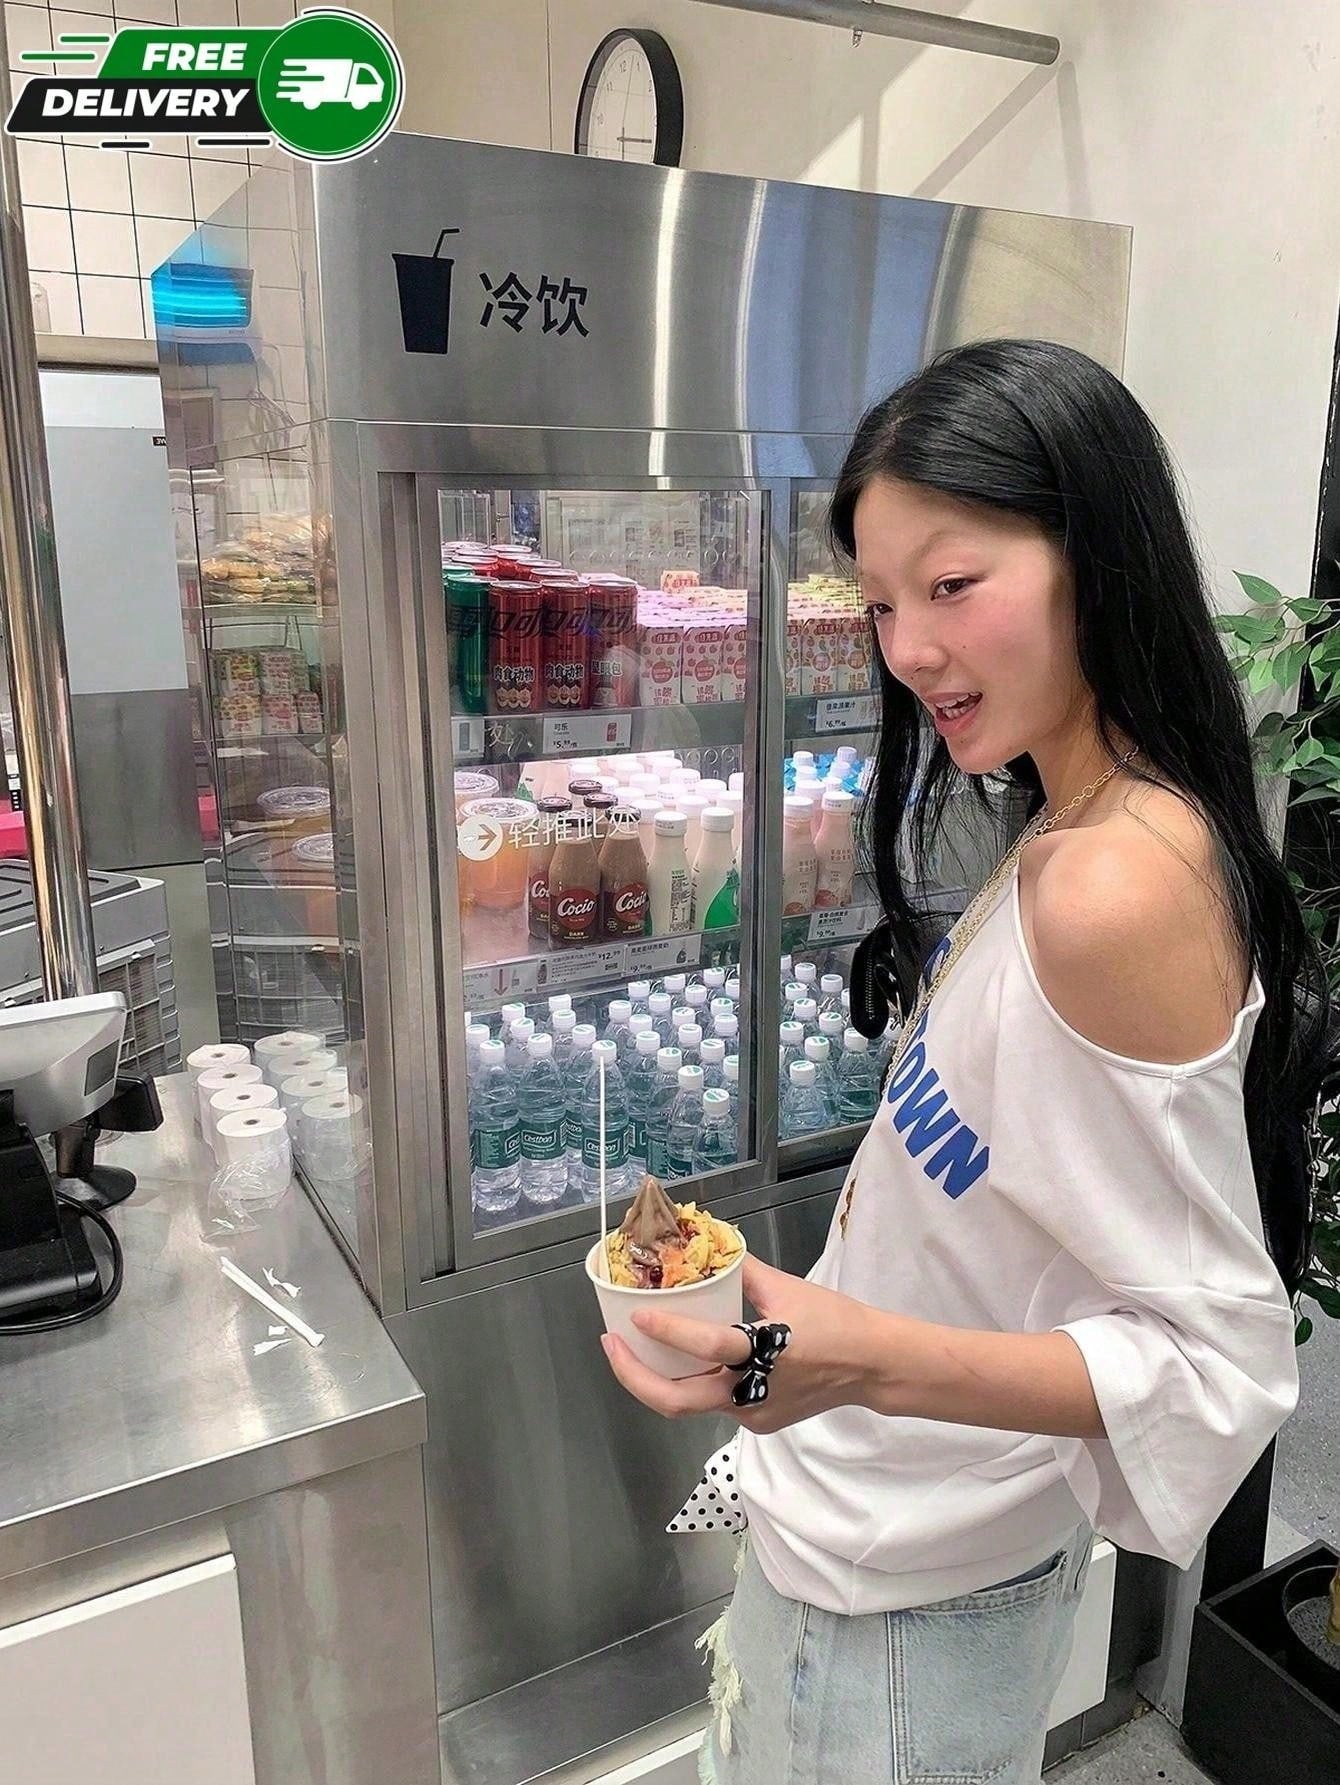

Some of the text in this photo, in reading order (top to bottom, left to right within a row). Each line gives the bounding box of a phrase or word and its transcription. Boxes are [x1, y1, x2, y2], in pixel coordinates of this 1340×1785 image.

[479, 271, 589, 338] 冷饮
[508, 807, 642, 850] 轻推此处
[557, 897, 596, 917] Cocio
